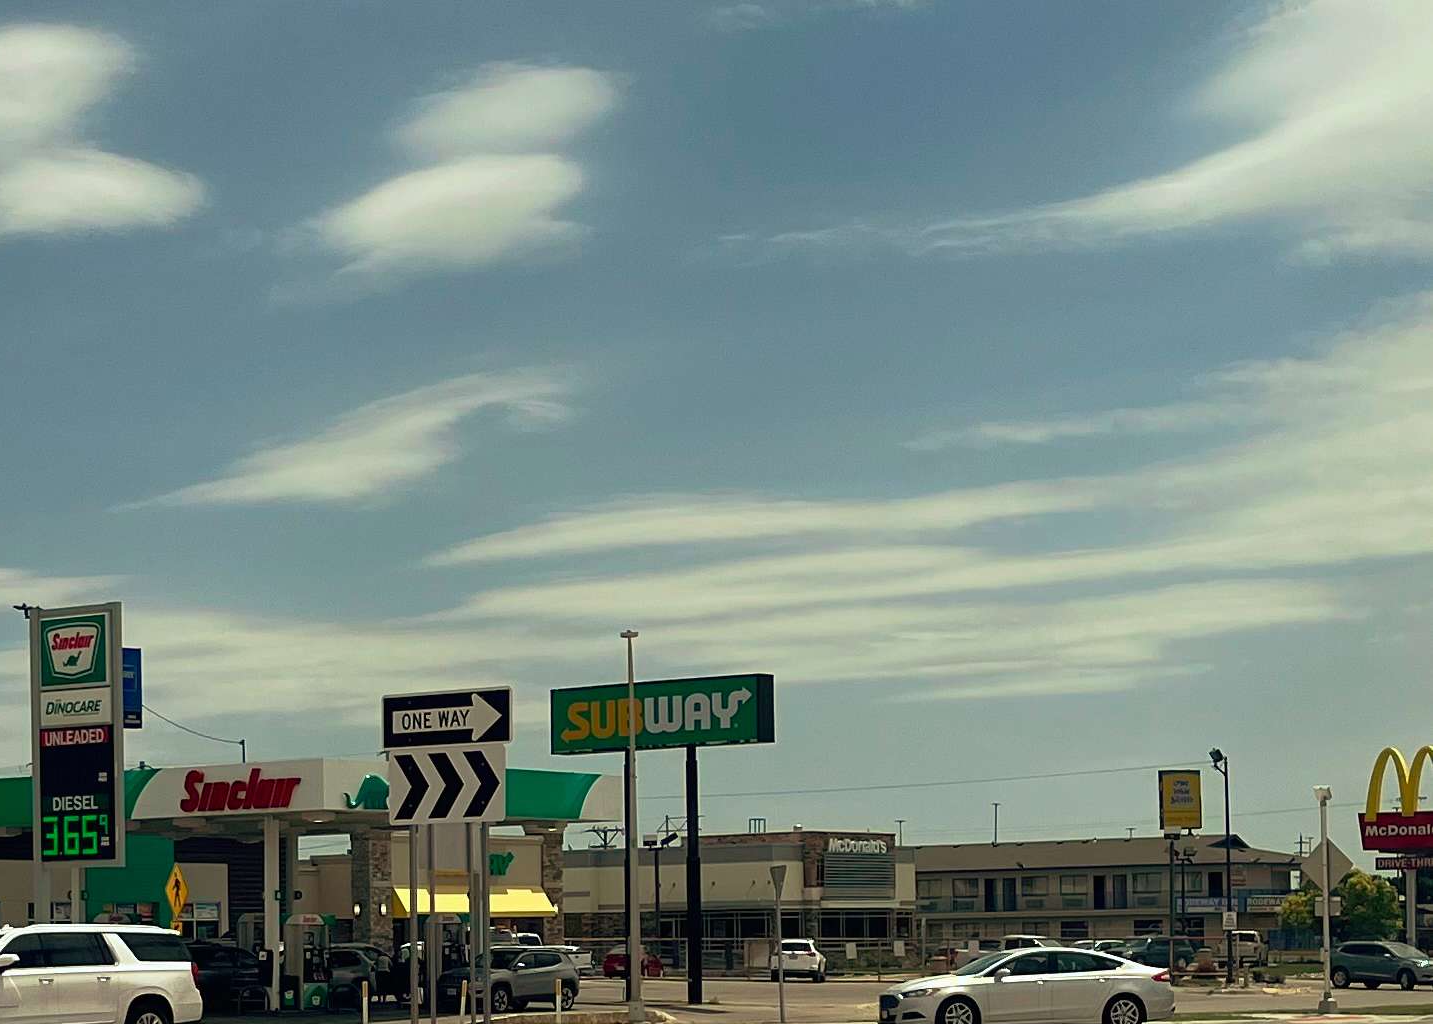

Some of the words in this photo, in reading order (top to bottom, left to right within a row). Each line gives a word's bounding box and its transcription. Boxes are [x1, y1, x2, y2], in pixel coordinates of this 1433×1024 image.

[51, 632, 94, 651] Sinclair
[46, 698, 102, 716] DINOCARE
[560, 687, 752, 742] SUBWAY
[401, 711, 432, 731] ONE
[438, 709, 470, 729] WAY
[45, 728, 105, 747] UNLEADED
[180, 768, 302, 812] Sinclair
[52, 796, 99, 812] DIESEL
[1365, 824, 1433, 838] McDonal
[828, 838, 887, 853] McDonald's
